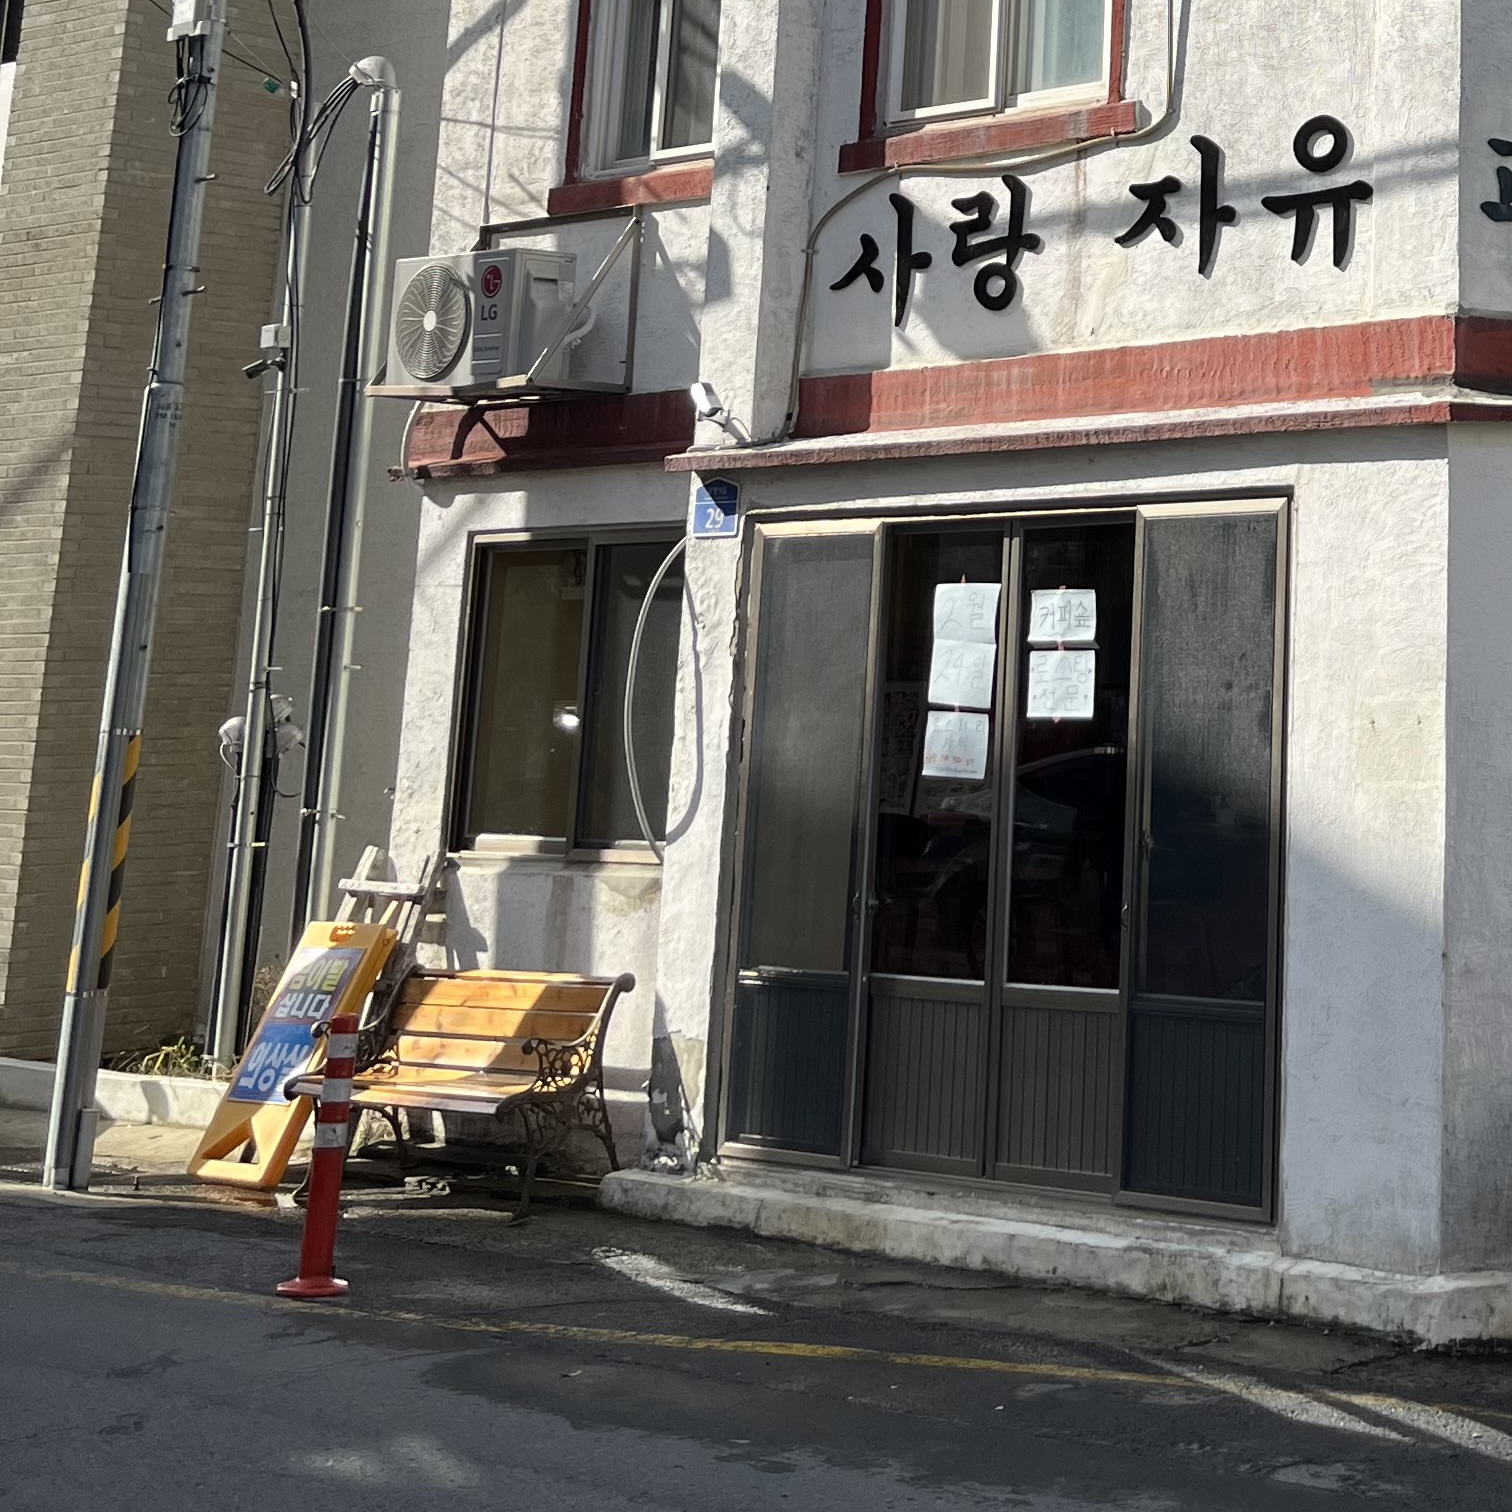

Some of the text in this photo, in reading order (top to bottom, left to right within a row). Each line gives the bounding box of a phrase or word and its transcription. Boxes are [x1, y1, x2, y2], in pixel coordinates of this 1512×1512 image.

[829, 114, 1374, 327] 사랑 자유
[481, 304, 498, 321] LG
[704, 508, 724, 529] 29
